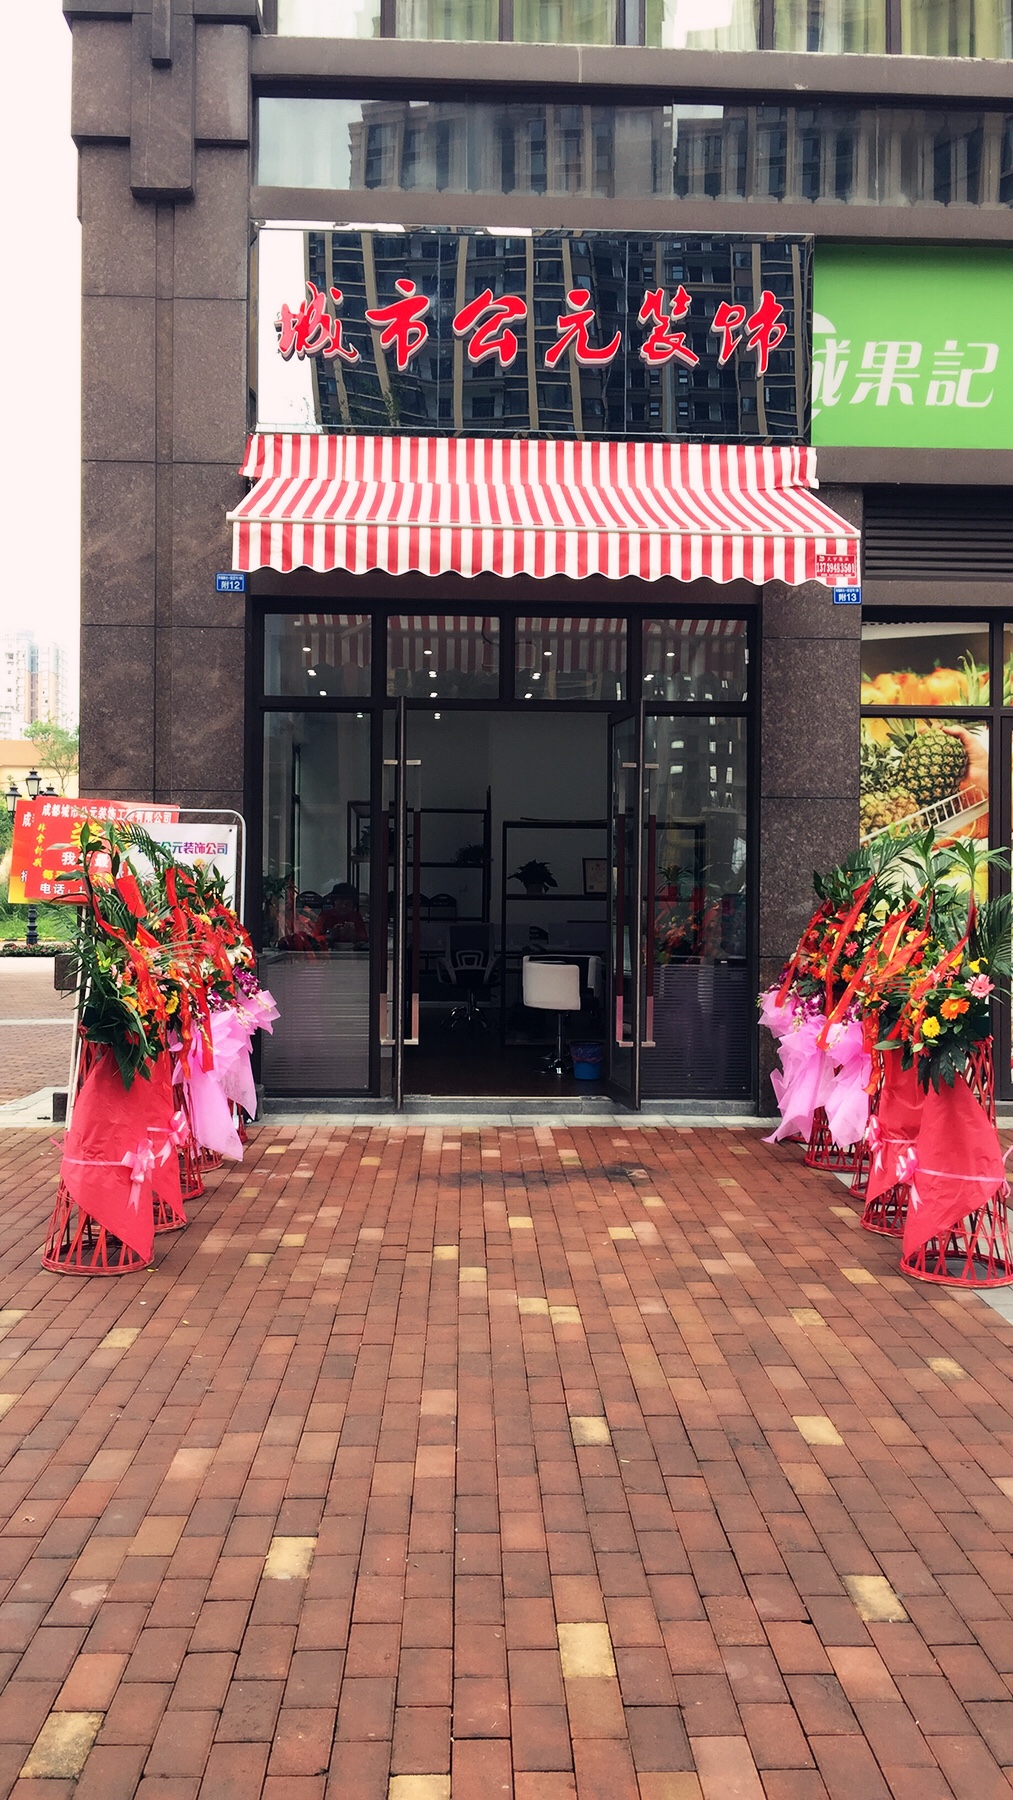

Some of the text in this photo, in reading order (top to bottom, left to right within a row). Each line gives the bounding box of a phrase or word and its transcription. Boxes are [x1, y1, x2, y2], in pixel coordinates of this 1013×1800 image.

[274, 278, 788, 378] 城市公元装饰
